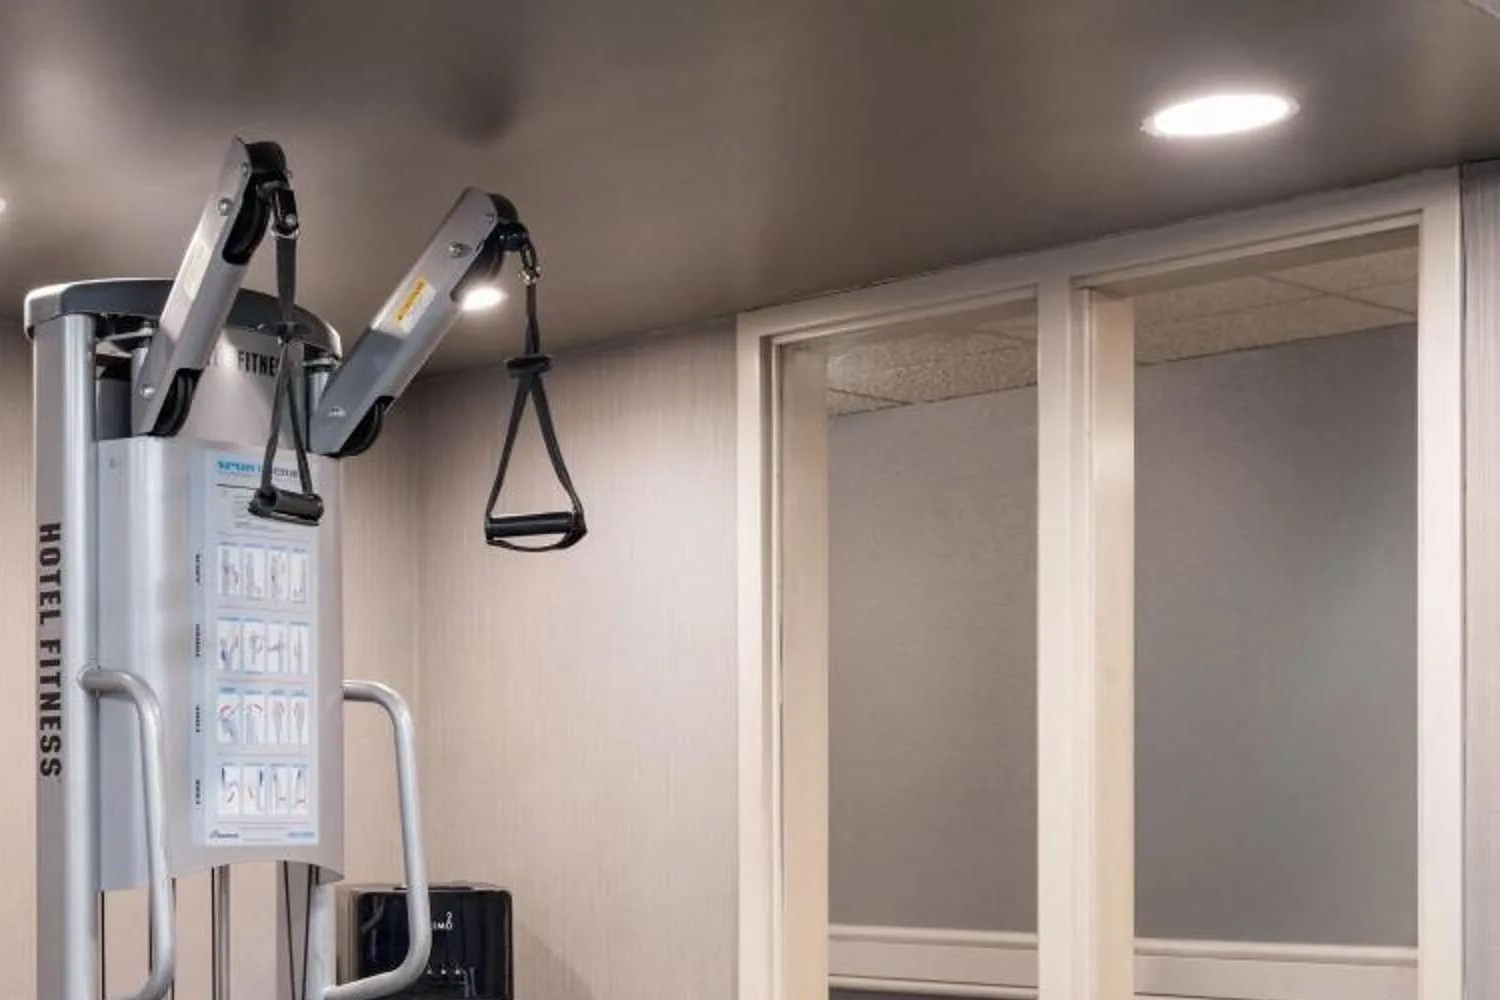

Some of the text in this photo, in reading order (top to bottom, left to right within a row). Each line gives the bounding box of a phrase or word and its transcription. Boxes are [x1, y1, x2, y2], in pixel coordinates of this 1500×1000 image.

[237, 350, 281, 378] FITNE
[39, 523, 62, 776] HOTEL FITNESS
